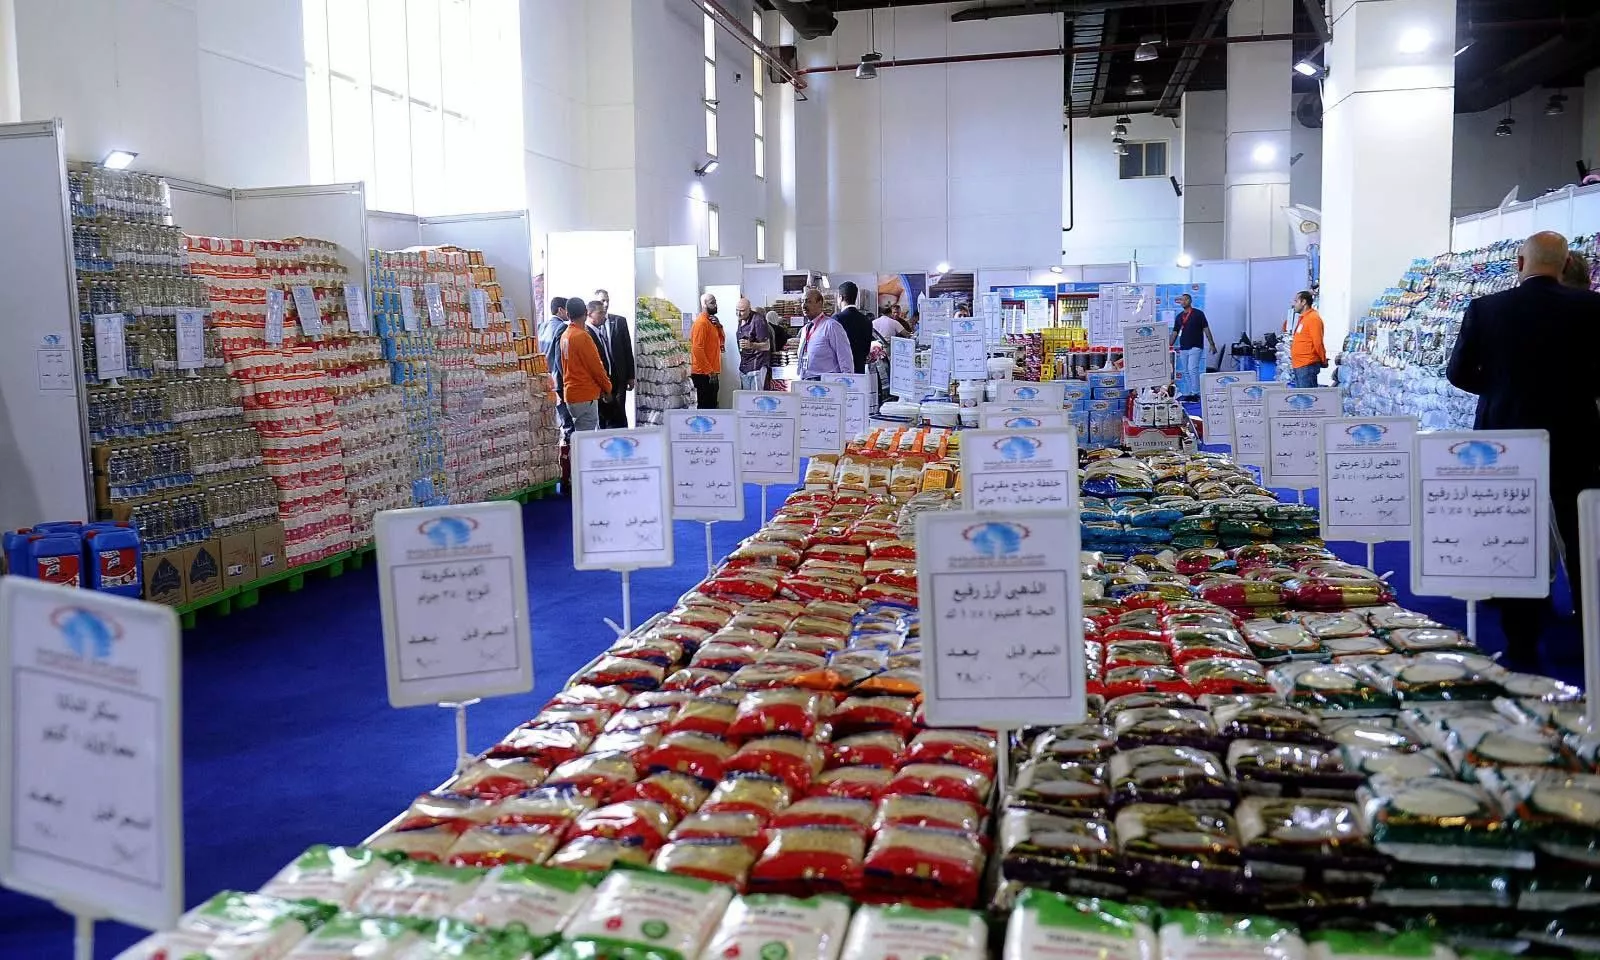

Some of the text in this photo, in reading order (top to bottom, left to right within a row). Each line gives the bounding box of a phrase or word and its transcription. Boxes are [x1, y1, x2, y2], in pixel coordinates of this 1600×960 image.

[776, 450, 790, 458] السعر
[1276, 451, 1293, 459] بعد
[1361, 457, 1374, 469] أرز
[678, 480, 694, 489] بعد
[705, 479, 732, 489] السعر قبل
[979, 478, 1061, 492] خلطة دجاج مقرمش
[1334, 495, 1355, 504] بعد
[1371, 494, 1405, 504] السعر قبل
[1428, 485, 1530, 503] لؤلؤة رشيد أرز رفيع
[979, 496, 995, 506] جرام
[1506, 504, 1531, 517] الحبة
[590, 519, 610, 529] بعد
[625, 516, 657, 528] السعر قبل
[1431, 536, 1460, 547] بعد
[1482, 535, 1529, 548] السعر قبل
[953, 581, 981, 604] رفيع
[983, 580, 1002, 600] أرز
[1027, 604, 1057, 619] الحبة
[407, 633, 440, 646] بعد
[461, 625, 509, 642] السعر قبل
[946, 648, 980, 662] بعد
[1006, 643, 1062, 660] السعر قبل
